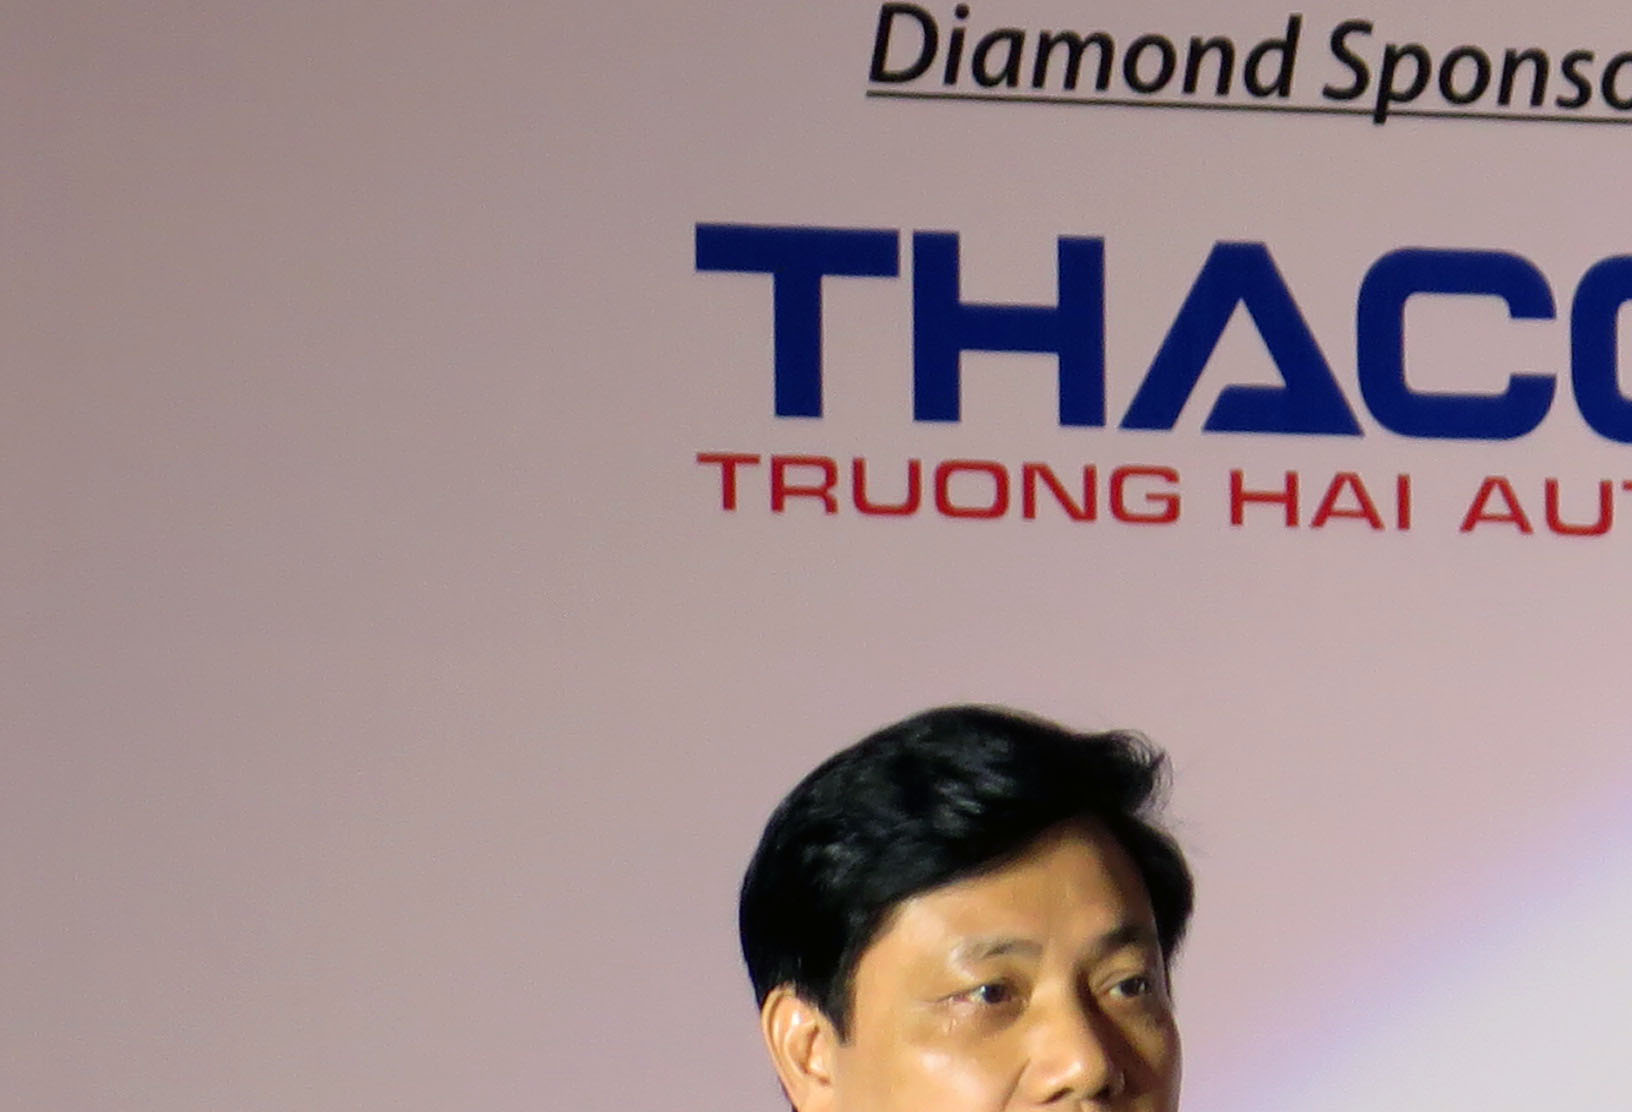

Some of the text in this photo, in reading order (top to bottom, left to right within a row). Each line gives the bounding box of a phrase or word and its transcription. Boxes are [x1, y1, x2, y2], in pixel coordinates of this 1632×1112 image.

[868, 2, 1302, 100] Diamond
[696, 451, 1181, 525] TRUONG
[1229, 469, 1411, 531] HAI
